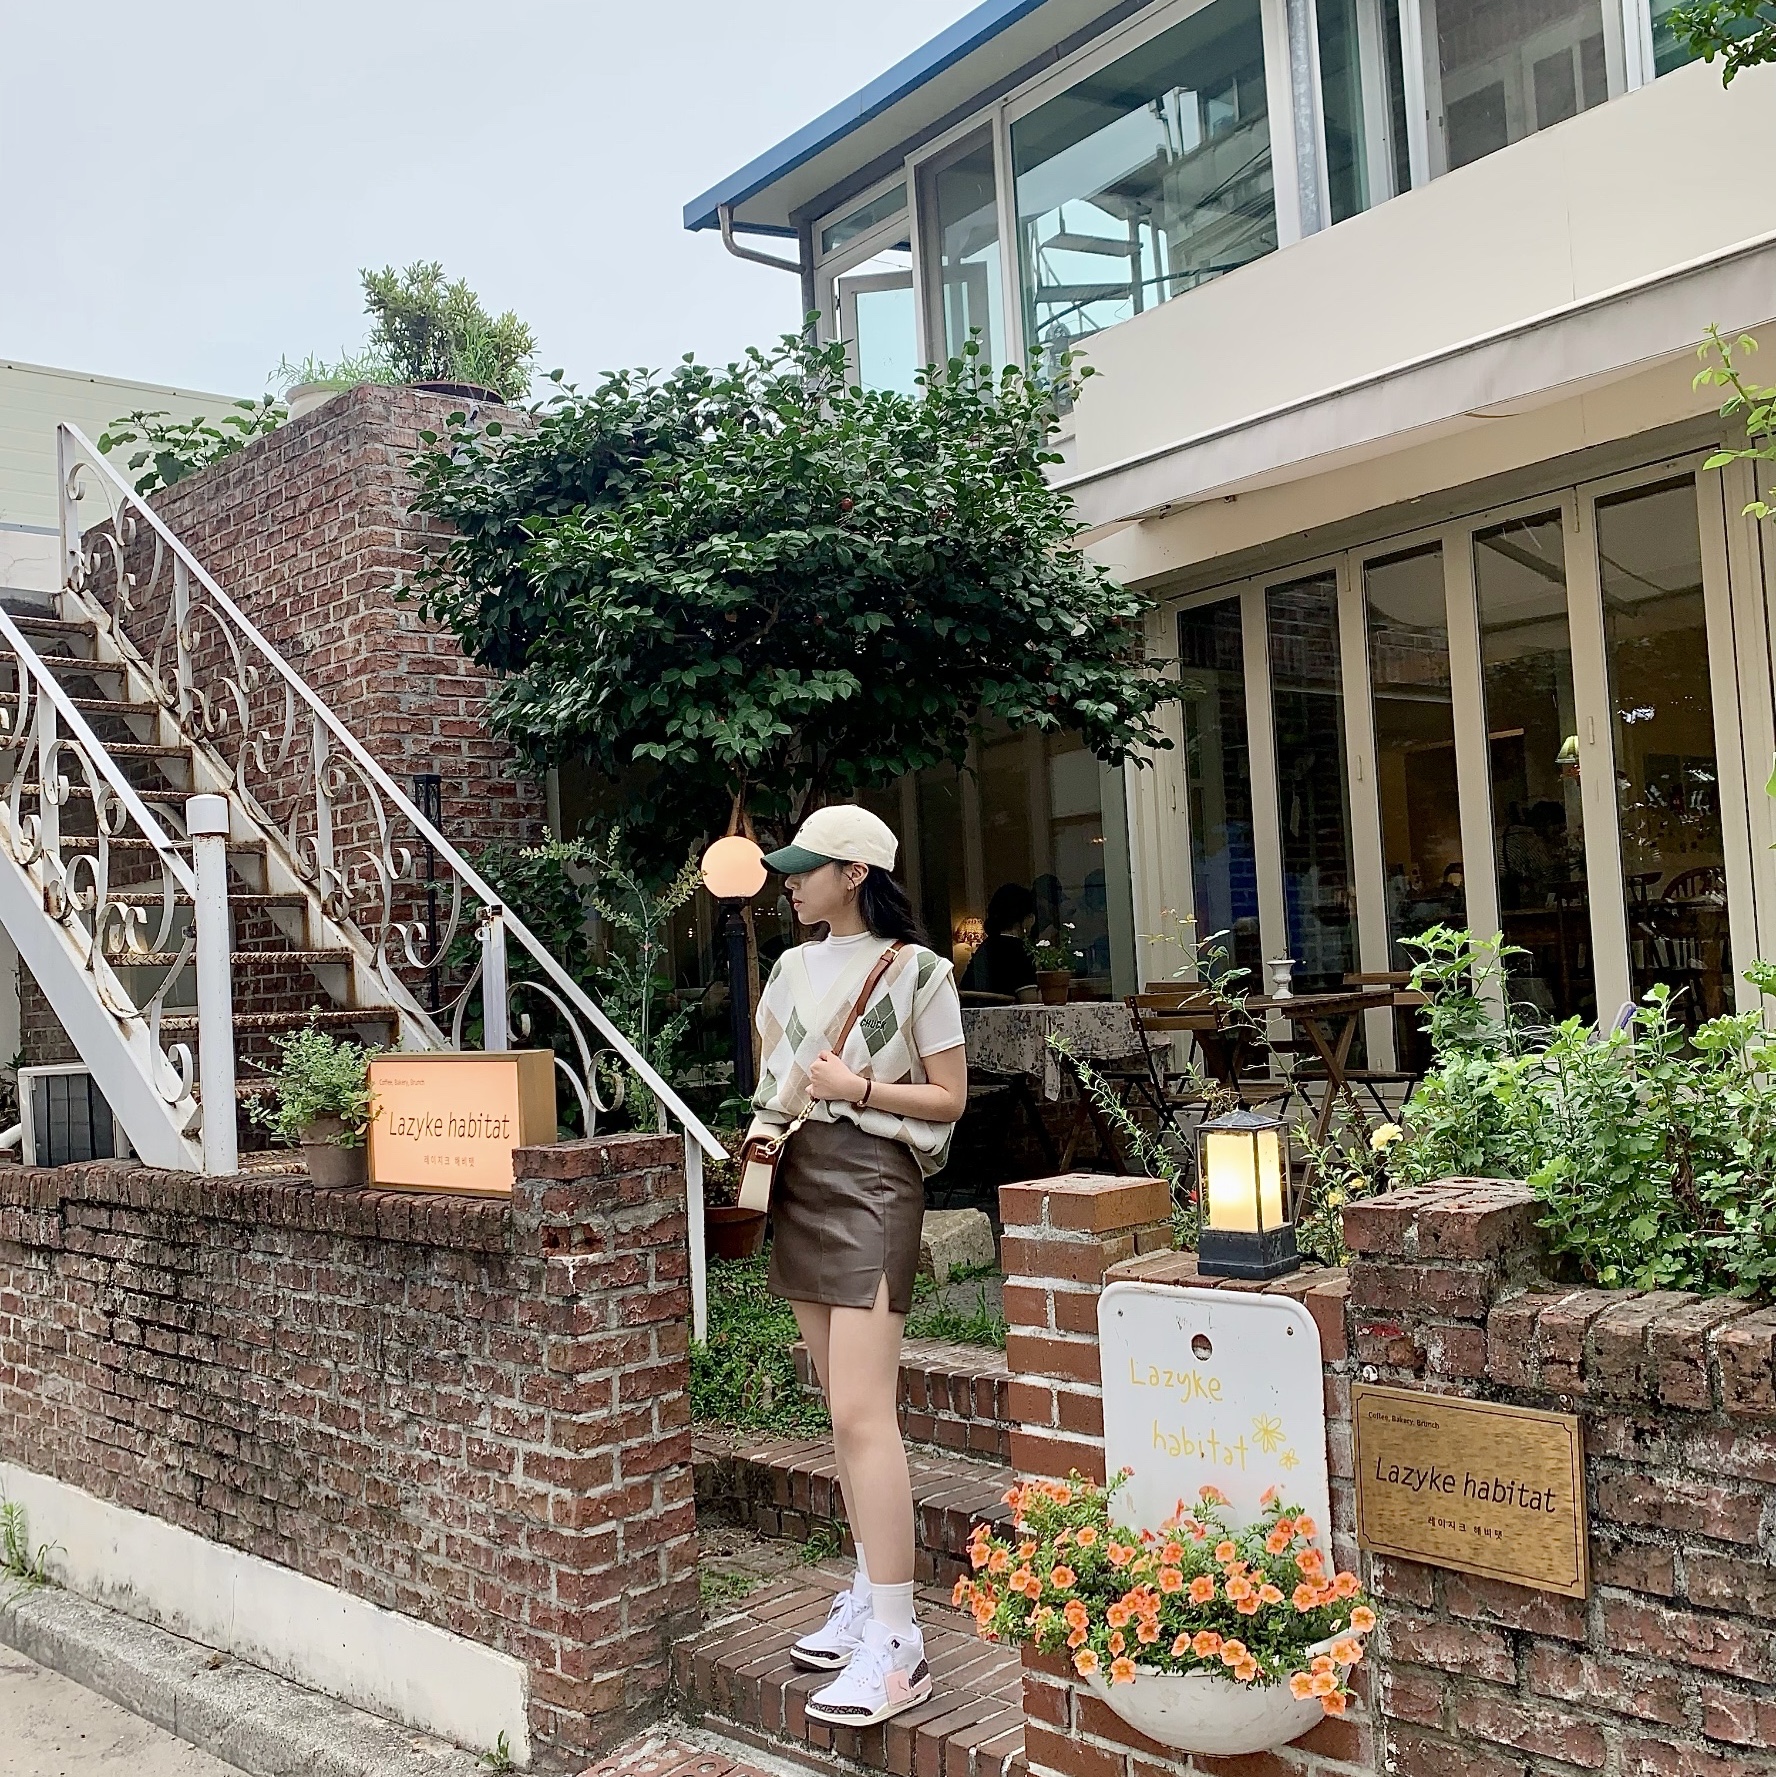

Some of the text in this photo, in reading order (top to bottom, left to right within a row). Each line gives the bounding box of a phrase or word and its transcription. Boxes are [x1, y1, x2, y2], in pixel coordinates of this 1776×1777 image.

[860, 1018, 887, 1030] CHUCK
[389, 1111, 510, 1141] Lazyke habitat
[1130, 1356, 1248, 1471] Lazyke habitat
[1416, 1419, 1440, 1430] Brunch
[1375, 1456, 1557, 1513] Lazyke habitat
[1427, 1516, 1467, 1532] 레이지크
